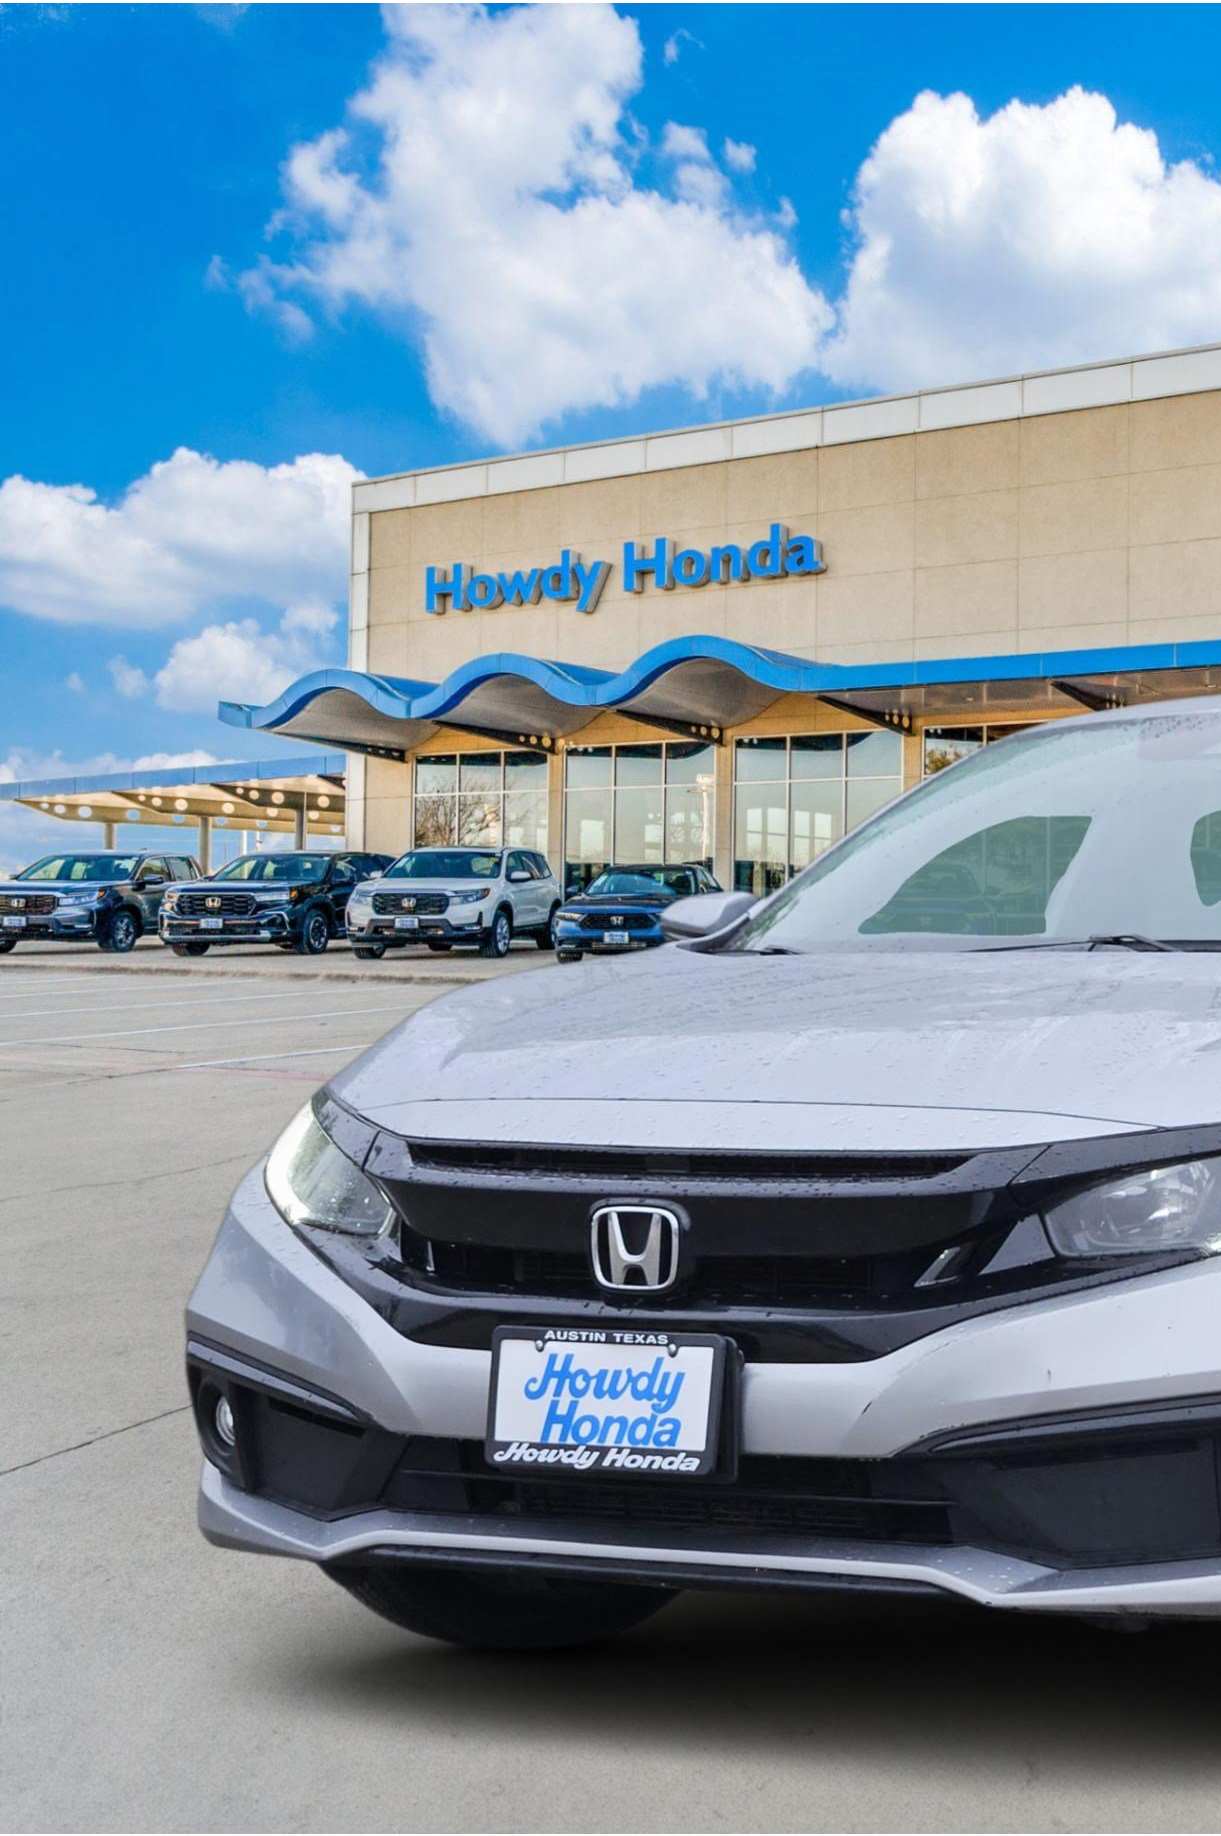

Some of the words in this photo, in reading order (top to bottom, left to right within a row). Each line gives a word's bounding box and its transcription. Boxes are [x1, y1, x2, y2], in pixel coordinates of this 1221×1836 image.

[425, 548, 613, 614] Howdy
[623, 523, 827, 593] Honda
[544, 1330, 606, 1343] AUSTIN
[613, 1332, 669, 1345] TEXAS
[524, 1353, 686, 1414] Howdy
[540, 1400, 682, 1447] Honda
[493, 1442, 601, 1469] Howdy
[602, 1448, 701, 1472] Honda
